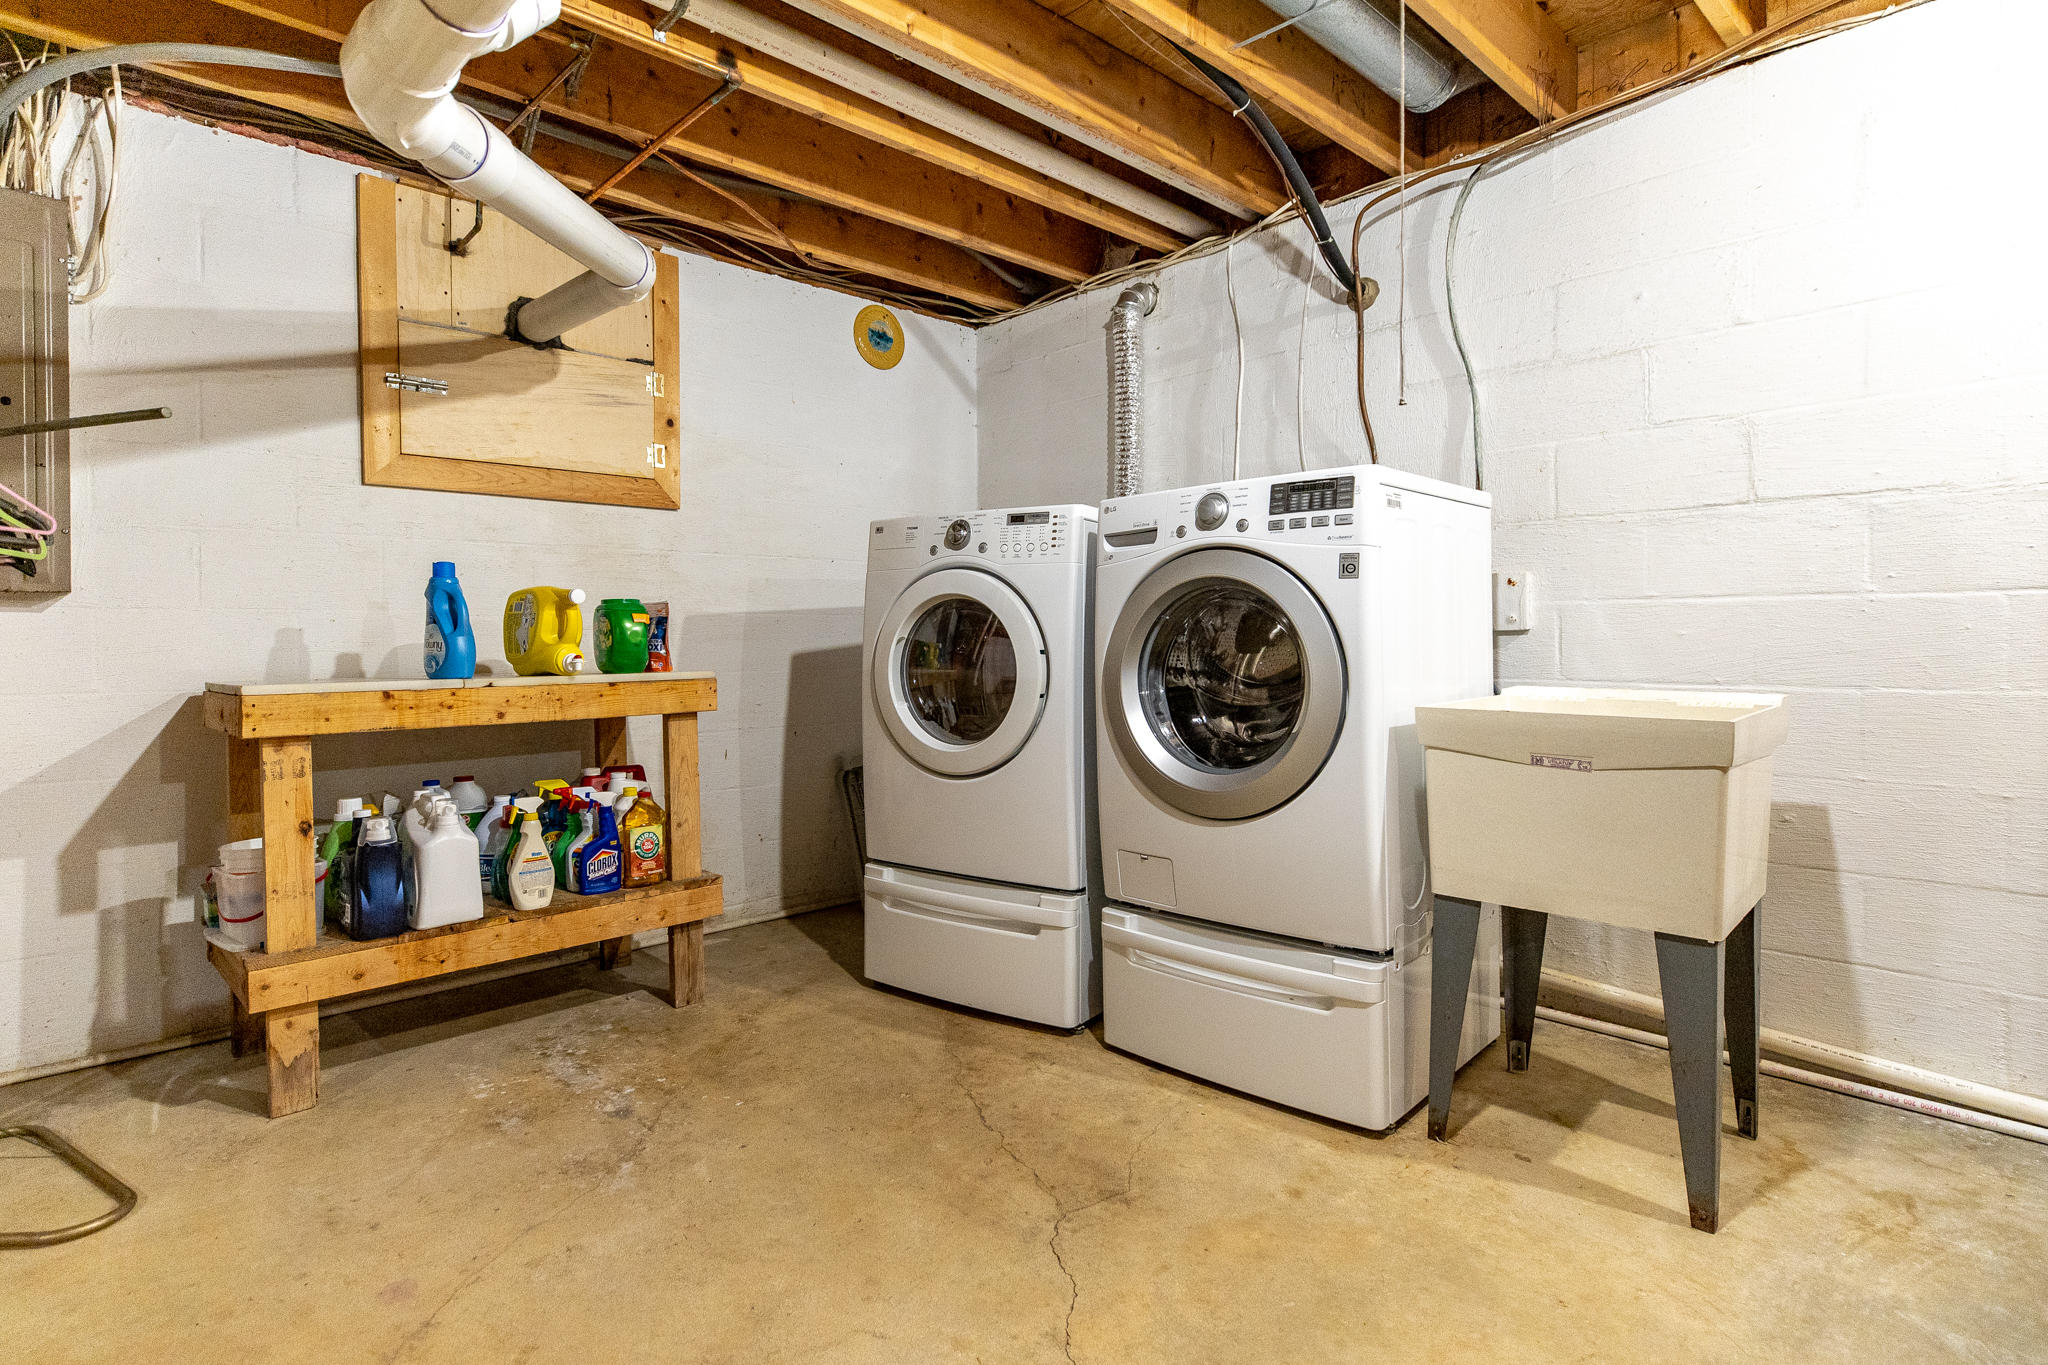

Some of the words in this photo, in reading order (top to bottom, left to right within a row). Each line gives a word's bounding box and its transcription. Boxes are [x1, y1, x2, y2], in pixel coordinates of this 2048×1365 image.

[648, 643, 663, 651] OXI
[635, 832, 659, 846] MURPHY
[588, 853, 617, 874] CLOROX
[1903, 1099, 1917, 1107] 200
